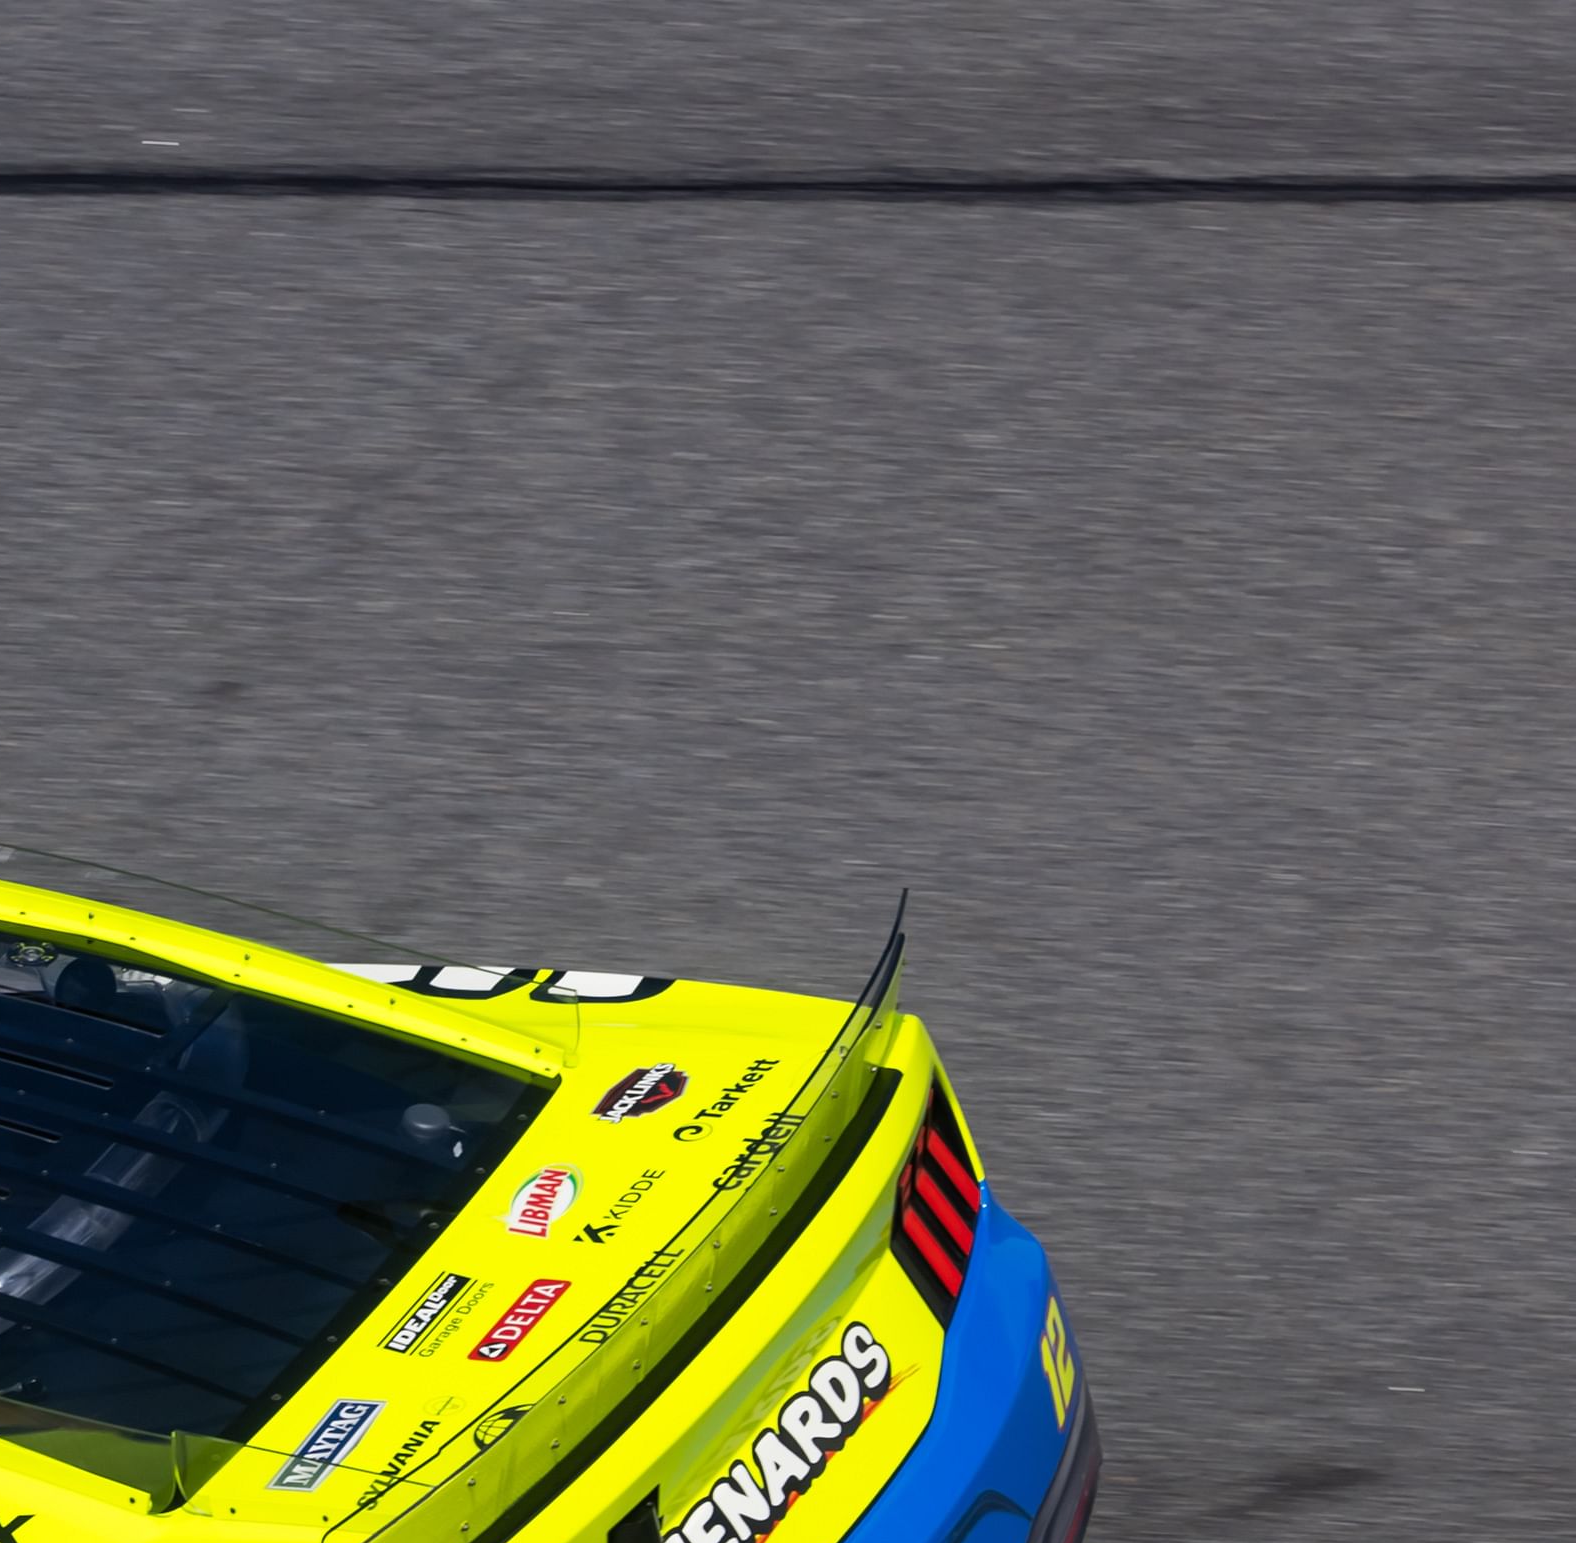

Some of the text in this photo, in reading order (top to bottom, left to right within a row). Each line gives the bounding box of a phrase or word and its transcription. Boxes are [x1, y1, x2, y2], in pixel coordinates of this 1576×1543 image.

[693, 1059, 780, 1120] Tarkett
[508, 1169, 569, 1239] LIBMAN
[604, 1169, 665, 1219] KIDDE
[388, 1299, 448, 1351] IDEAL
[418, 1282, 495, 1358] Garage Doors
[490, 1283, 566, 1340] DELTA
[579, 1249, 685, 1344] DURACELL
[1041, 1296, 1076, 1430] 12
[283, 1402, 370, 1487] MAYTAG
[356, 1419, 441, 1511] SYLVANIA
